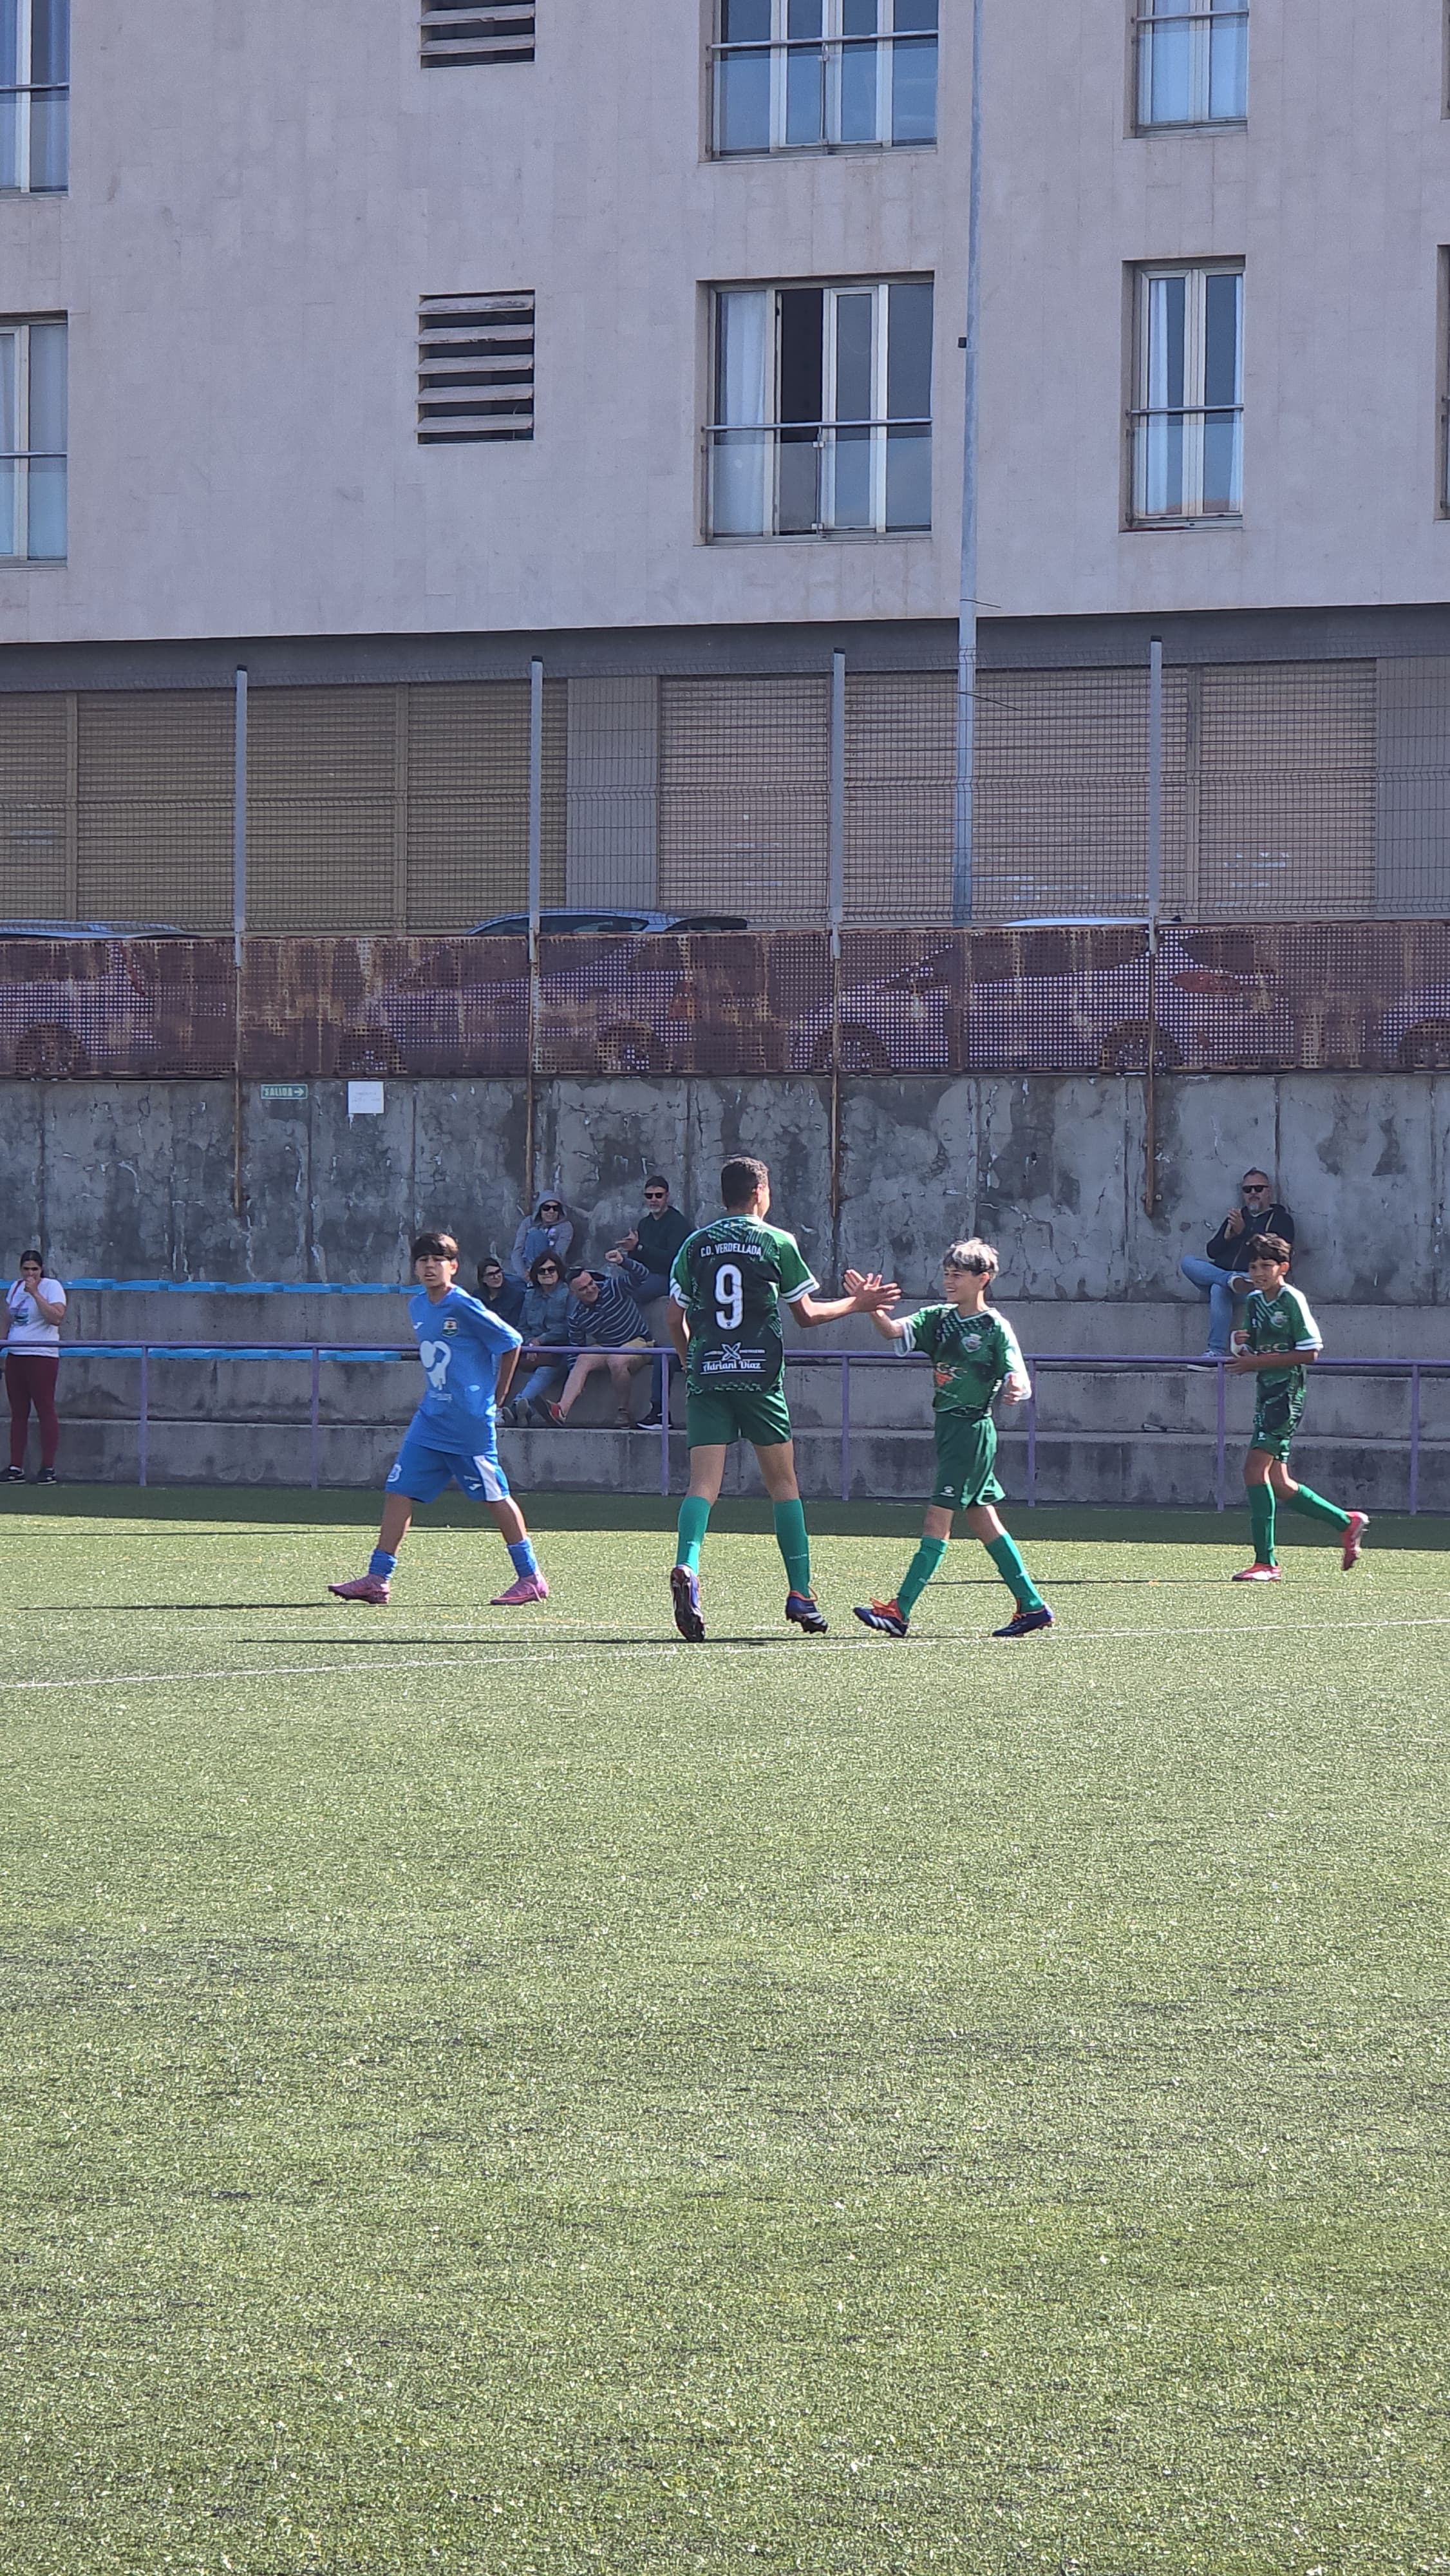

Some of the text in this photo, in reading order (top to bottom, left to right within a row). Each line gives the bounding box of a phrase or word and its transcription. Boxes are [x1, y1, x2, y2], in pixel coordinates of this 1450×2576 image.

[265, 1087, 293, 1097] SALIDA
[700, 1242, 762, 1258] C.D. VERDELLADA
[715, 1263, 743, 1331] 9
[702, 1359, 737, 1372] Adriani
